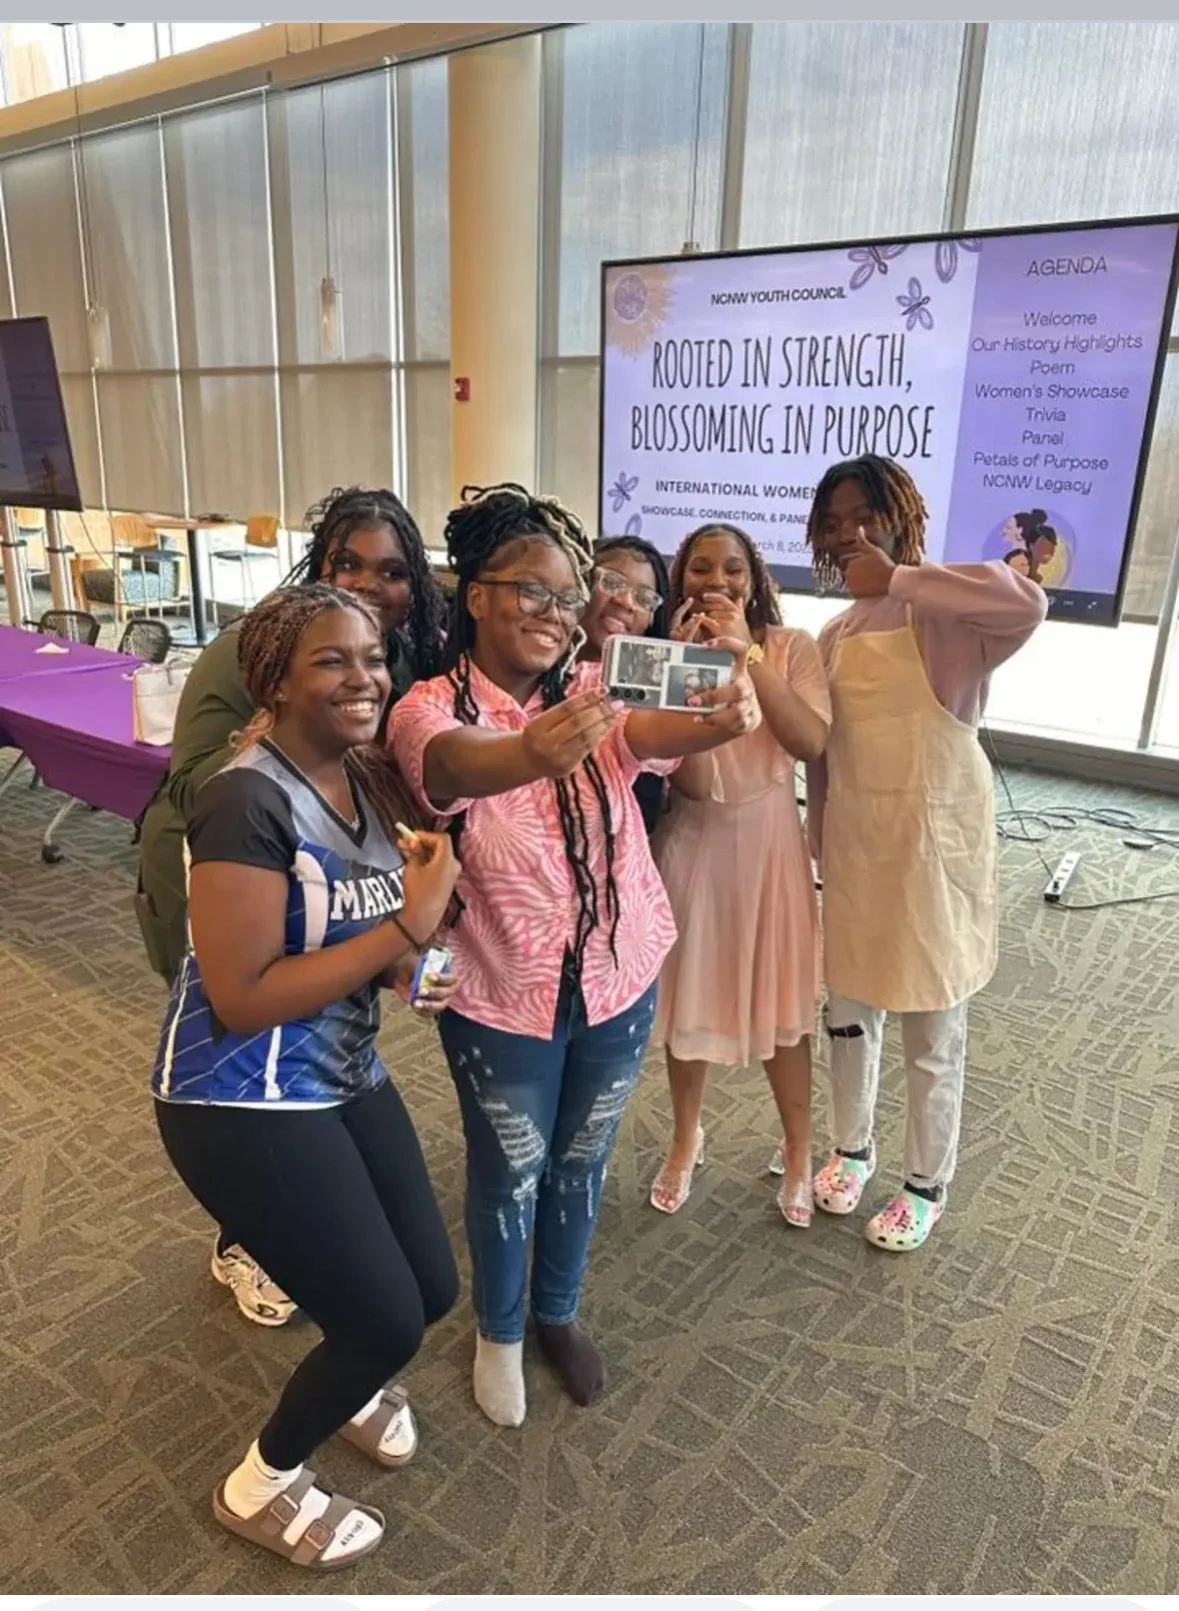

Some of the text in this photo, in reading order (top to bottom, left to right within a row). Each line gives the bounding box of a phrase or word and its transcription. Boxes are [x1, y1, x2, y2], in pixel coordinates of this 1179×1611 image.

[1027, 256, 1107, 277] AGENDA
[711, 286, 846, 306] NCNW YOUTH COUNCIL
[1024, 311, 1098, 327] Welcome
[971, 332, 1143, 354] Our History Highlights
[652, 333, 913, 393] ROOTED IN STRENGTH,
[1030, 359, 1076, 375] Poem
[975, 383, 1130, 399] Women's Showcase
[1025, 406, 1067, 423] Trivia
[631, 403, 935, 458] BLOSSOMING IN PURPOSE
[1021, 429, 1064, 446] Panel
[973, 451, 1109, 472] Petals of Purpose
[655, 480, 818, 500] INTERNATIONAL WOMEN
[982, 473, 1093, 495] NCNW Legacy
[769, 513, 777, 523] &
[779, 513, 807, 525] PANE
